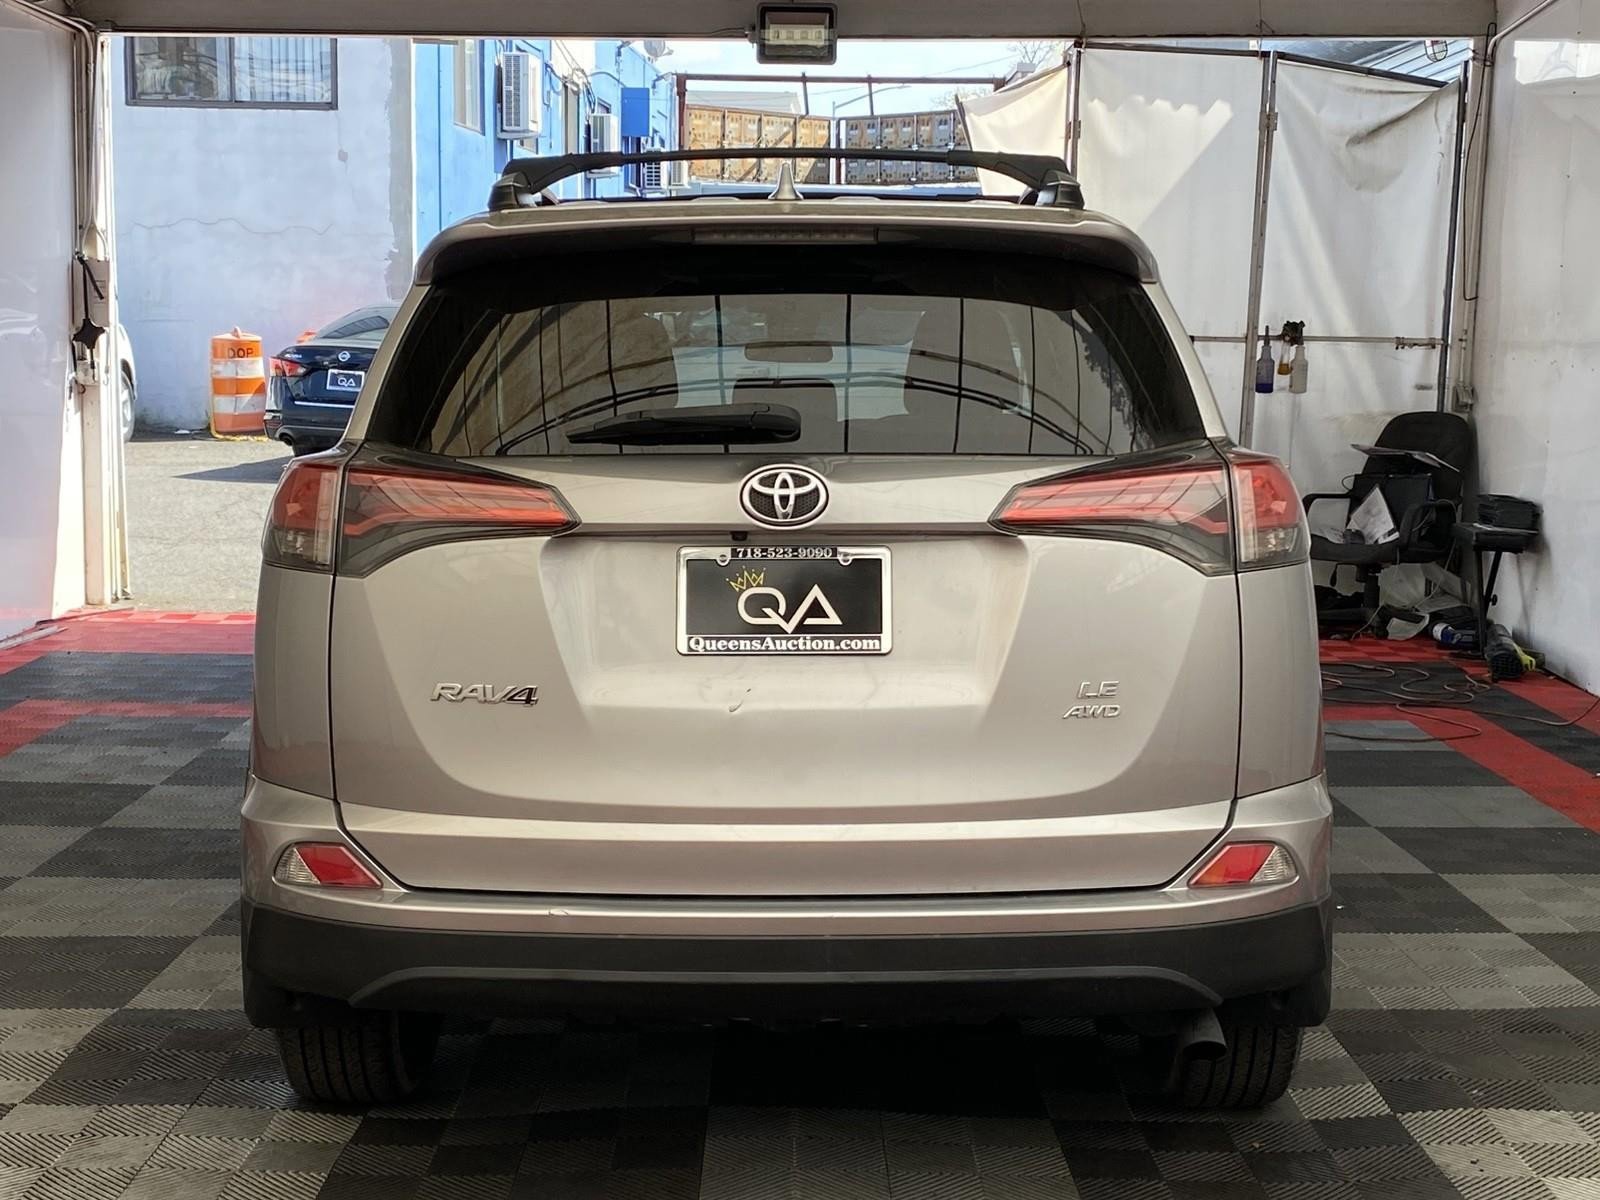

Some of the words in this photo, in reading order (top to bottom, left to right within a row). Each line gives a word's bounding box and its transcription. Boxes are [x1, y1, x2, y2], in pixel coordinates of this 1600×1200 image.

[337, 377, 356, 387] QA
[736, 547, 832, 559] 718-523-9090
[737, 583, 843, 634] QA
[689, 636, 881, 652] QueensAuction.com
[430, 682, 539, 706] RAV4
[1077, 680, 1119, 699] LE
[1062, 704, 1120, 719] AWD
